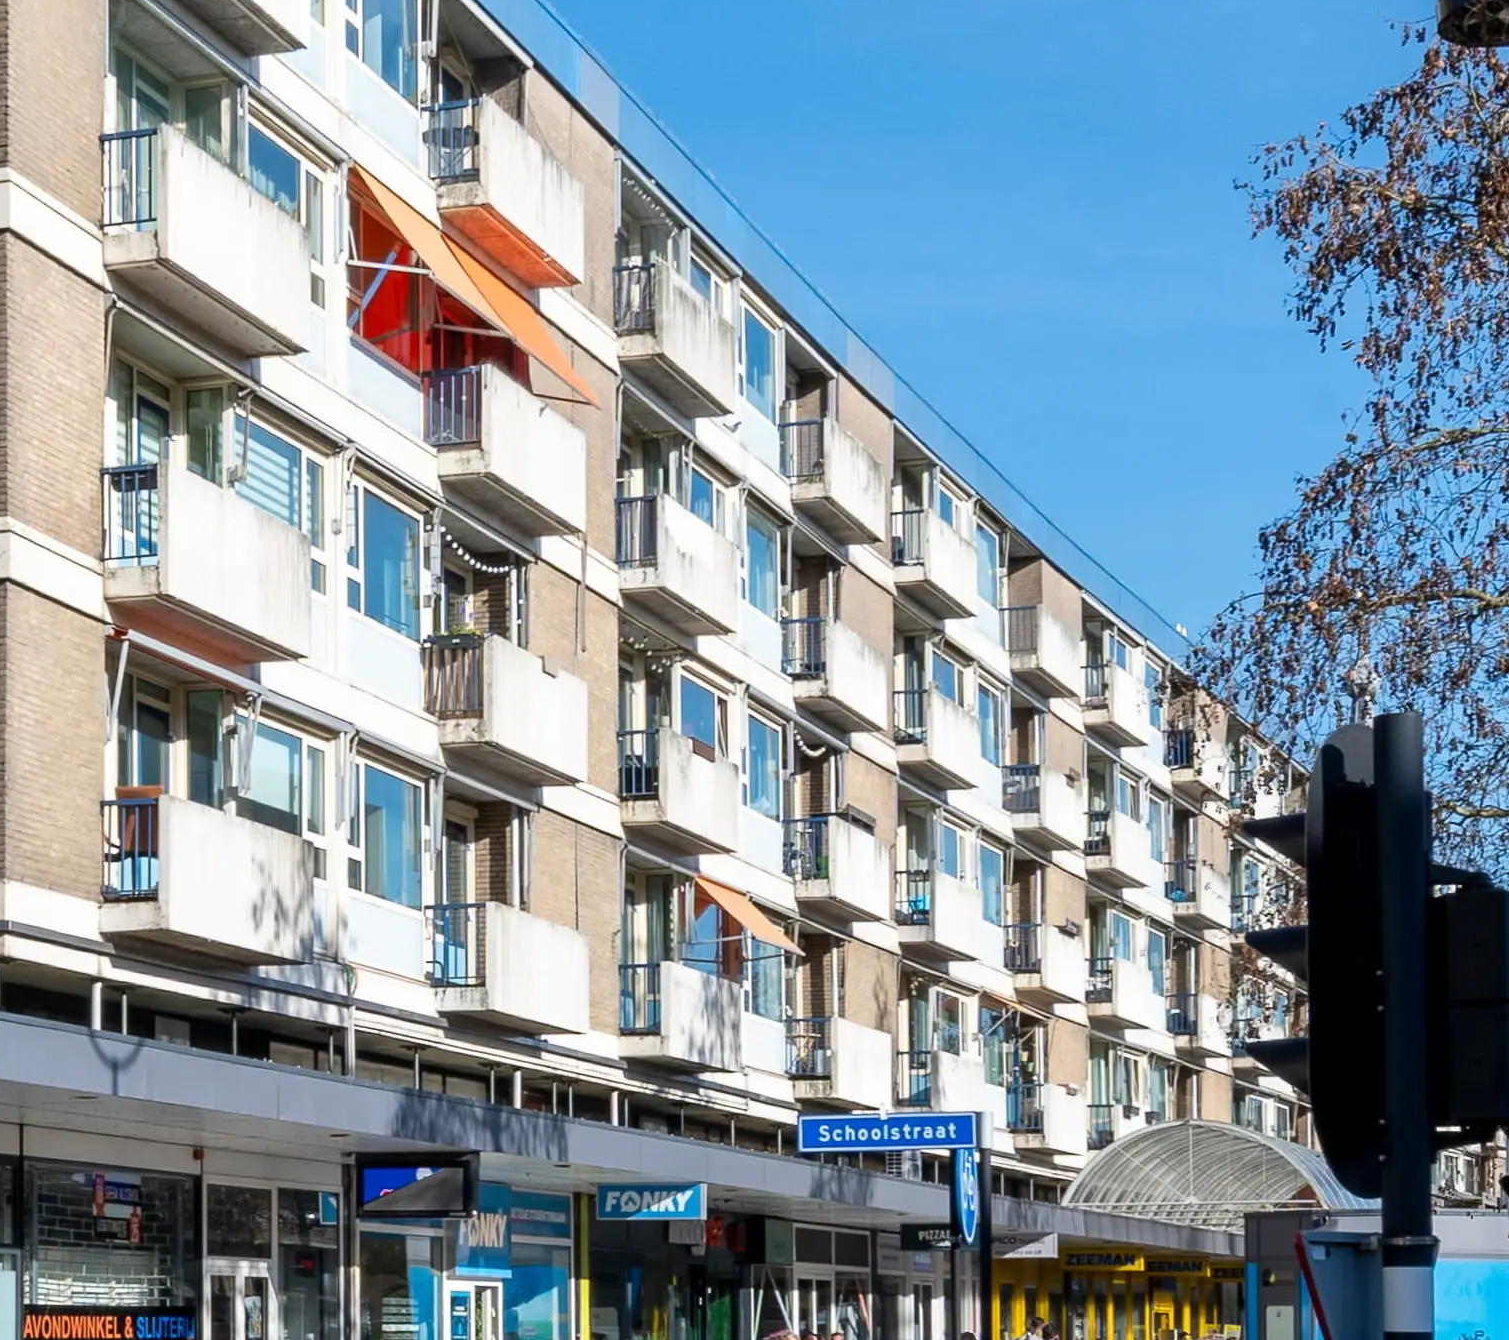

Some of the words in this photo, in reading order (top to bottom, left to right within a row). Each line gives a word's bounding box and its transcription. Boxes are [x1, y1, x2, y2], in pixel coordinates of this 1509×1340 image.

[817, 1121, 959, 1143] Schoolstraat
[604, 1190, 694, 1213] FONKY
[1066, 1253, 1136, 1266] ZEEMAN
[1147, 1260, 1202, 1272] EEMAN
[23, 1314, 122, 1340] AVONDWINKEL
[124, 1315, 134, 1339] &
[135, 1314, 196, 1340] SLIJTERIJ
